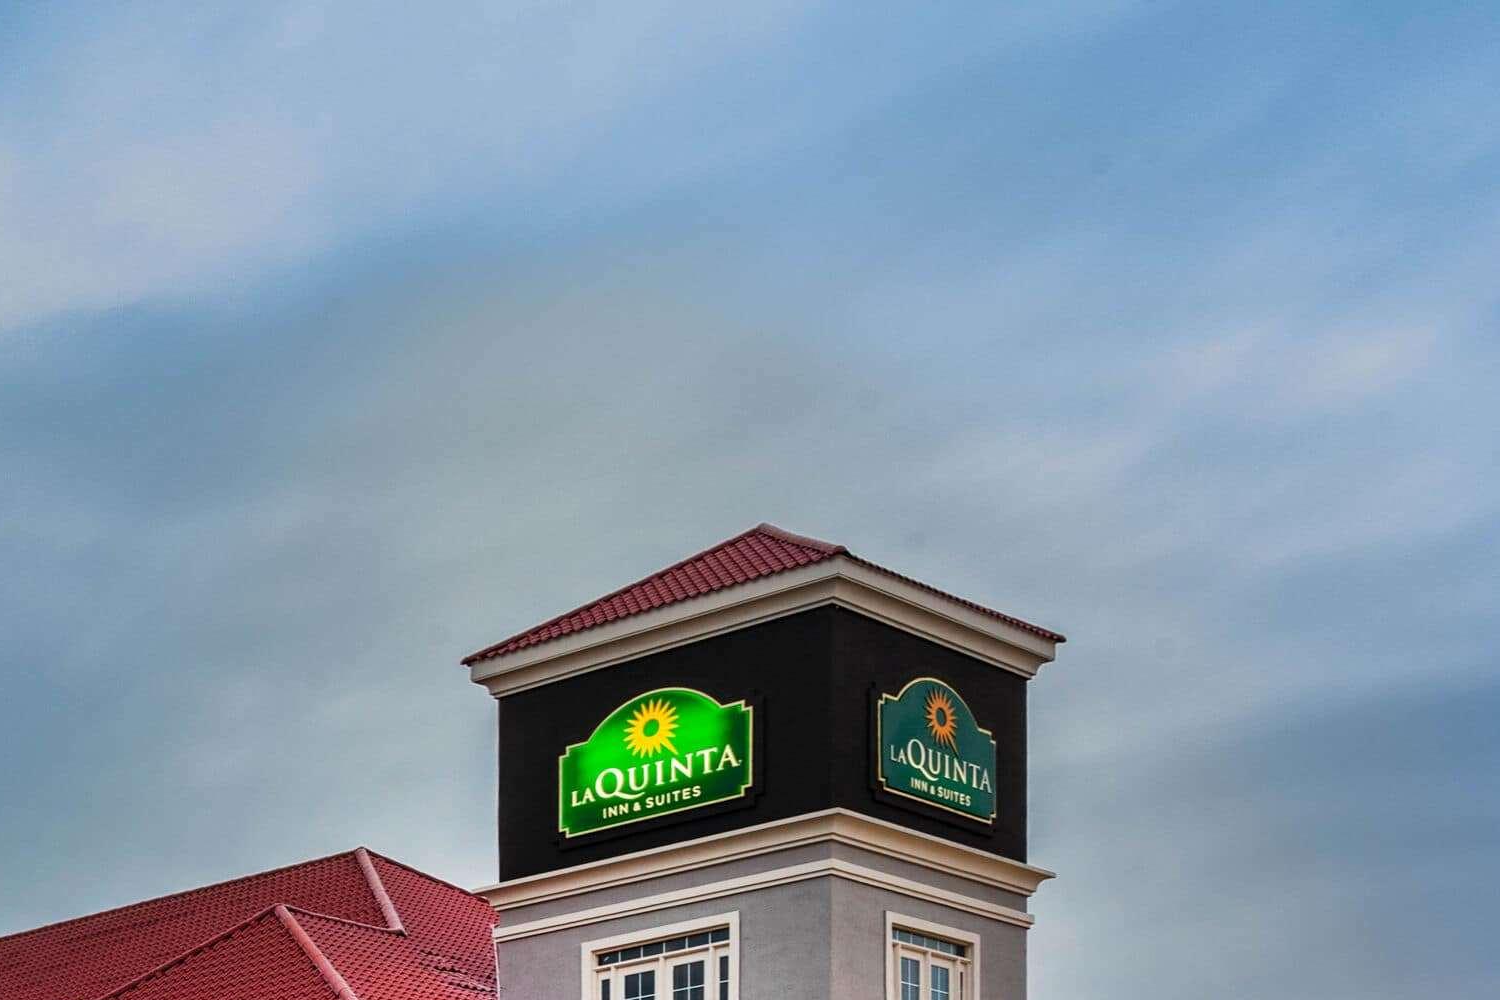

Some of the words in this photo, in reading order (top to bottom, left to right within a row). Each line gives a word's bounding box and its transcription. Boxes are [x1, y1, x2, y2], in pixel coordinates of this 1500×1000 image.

[595, 743, 742, 799] QUINTA
[907, 738, 992, 794] QUINTA
[602, 802, 629, 819] INN
[633, 801, 641, 812] &
[645, 785, 701, 808] SUITES
[910, 777, 928, 794] INN
[929, 785, 936, 795] &
[937, 786, 971, 807] SUITES
